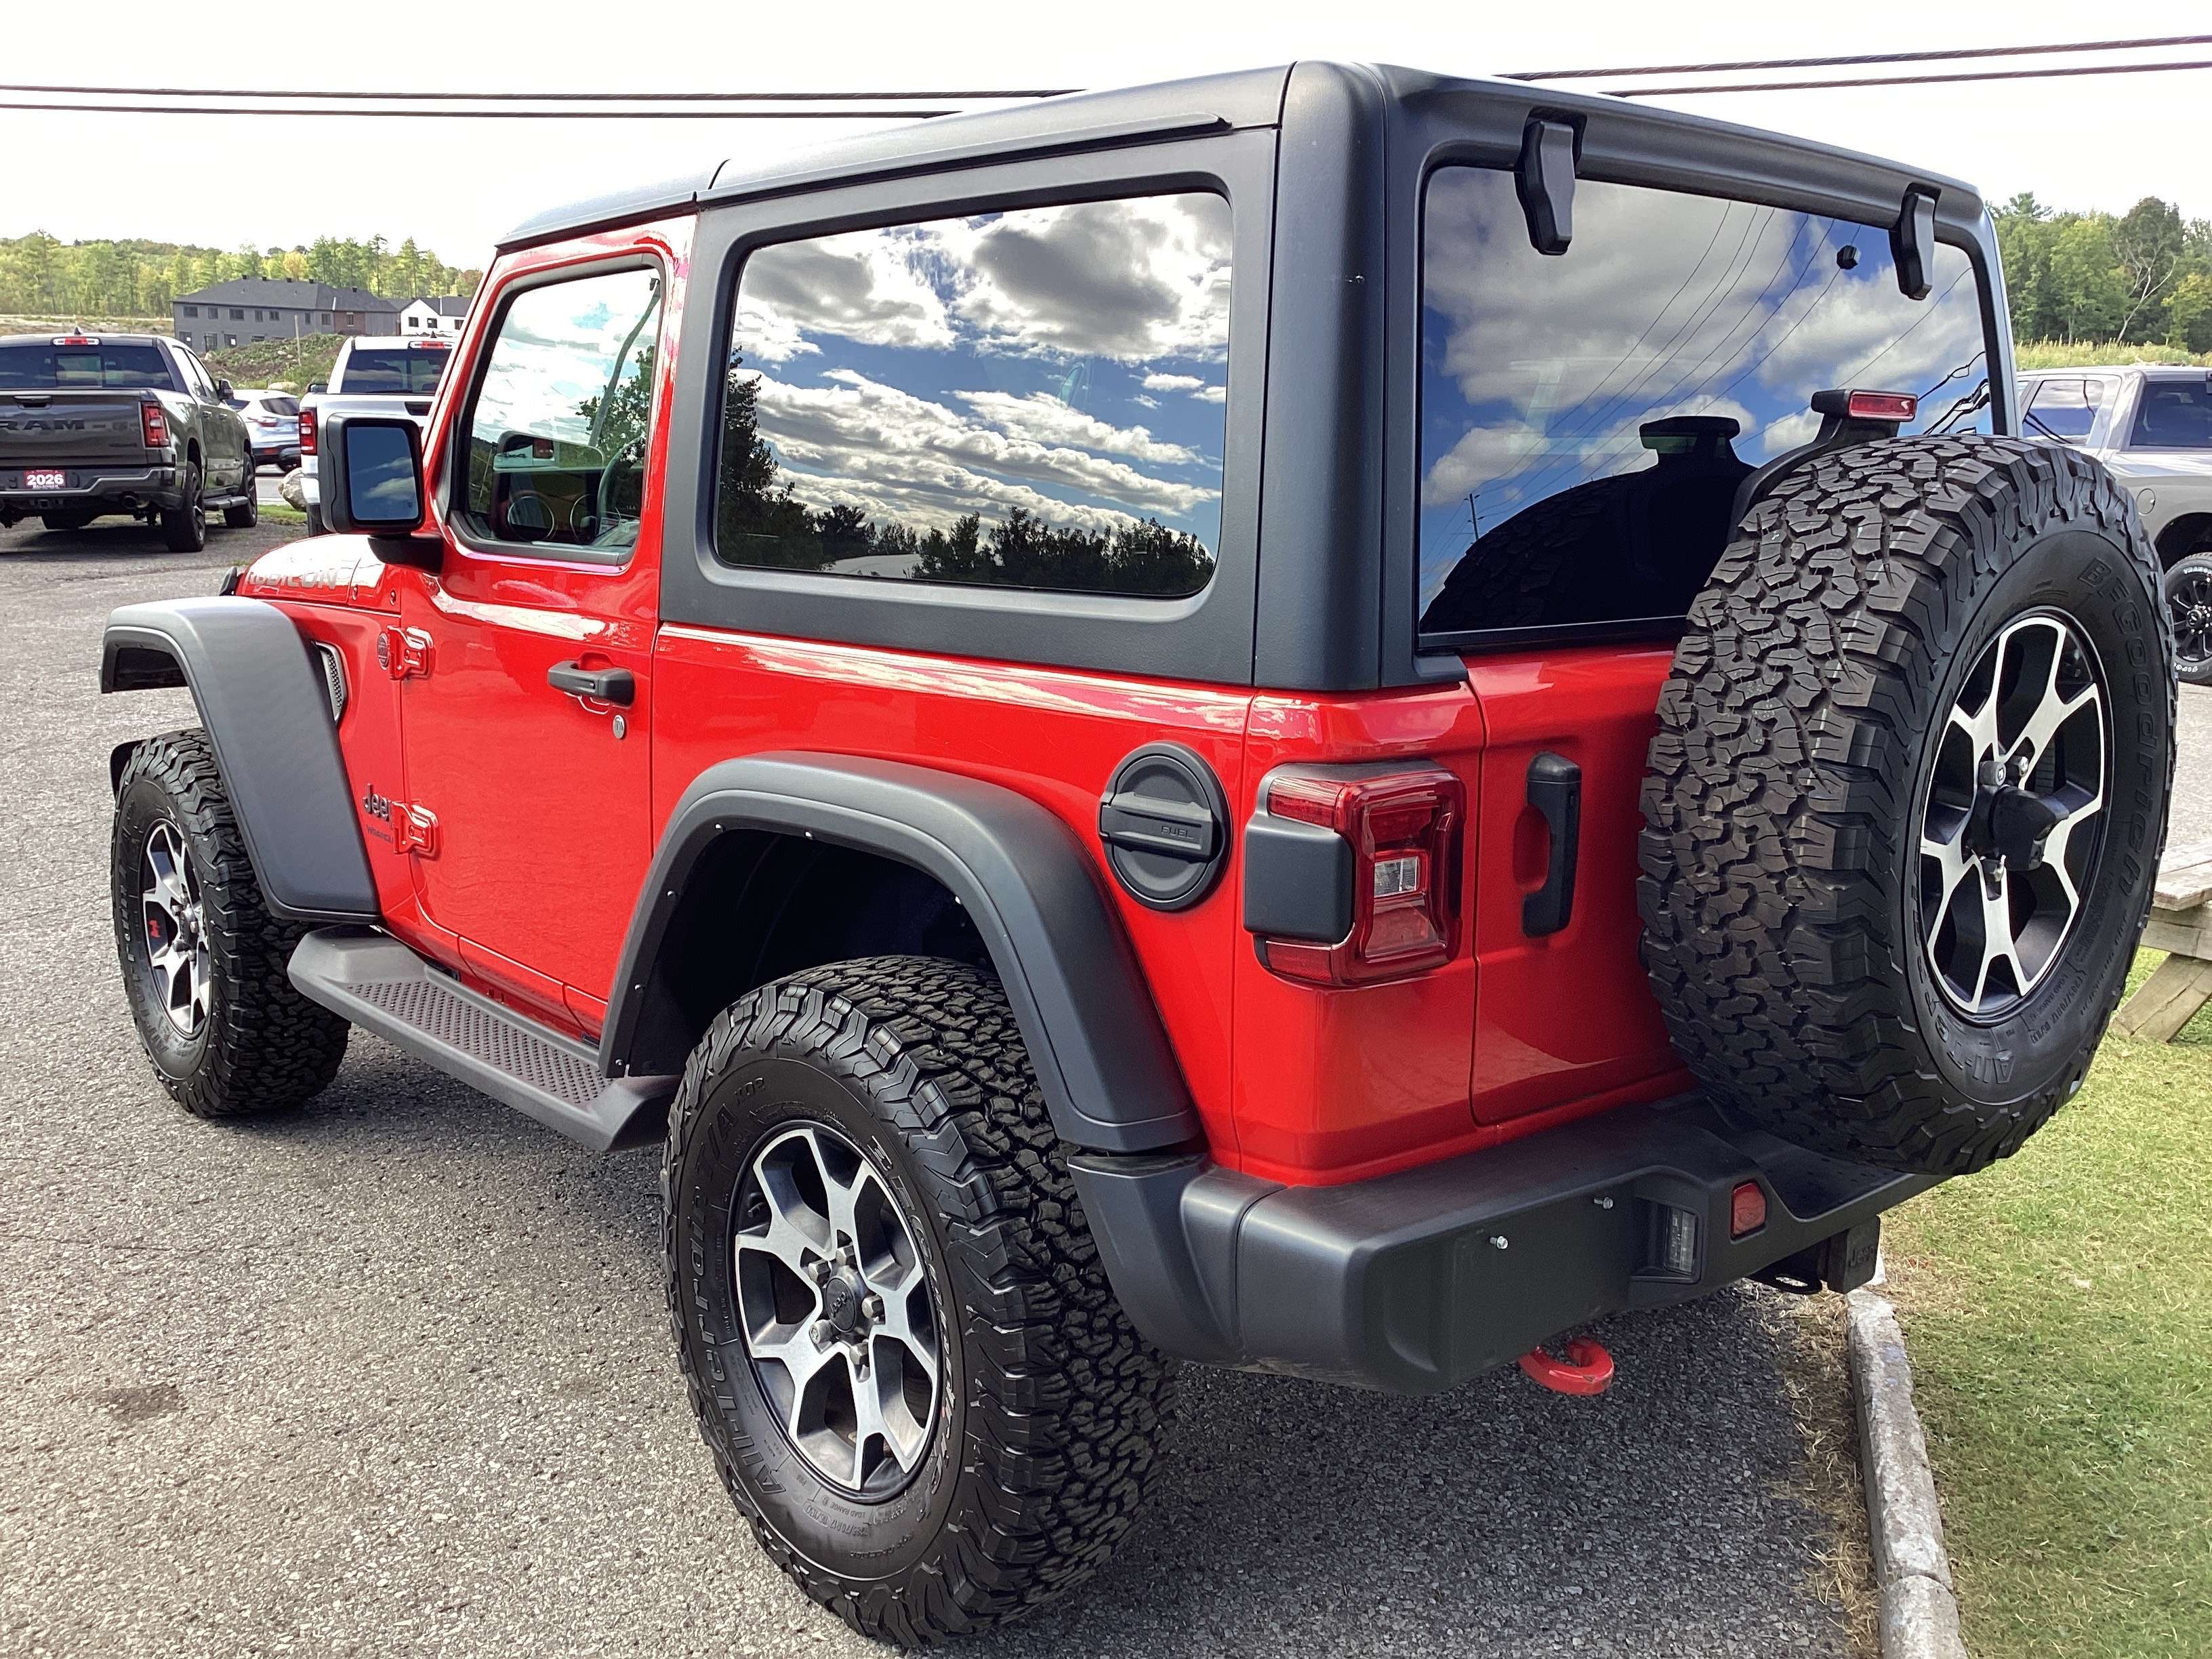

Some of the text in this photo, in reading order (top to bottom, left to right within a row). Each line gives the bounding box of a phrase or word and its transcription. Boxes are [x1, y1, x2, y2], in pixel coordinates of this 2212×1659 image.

[0, 419, 85, 430] RAM
[26, 474, 64, 486] 2026
[2077, 554, 2158, 899] BFGoodrich
[1160, 825, 1194, 840] FUEL
[1849, 1247, 1876, 1267] Jeep
[830, 1291, 846, 1321] Jeep
[685, 1183, 786, 1496] All-Terrain
